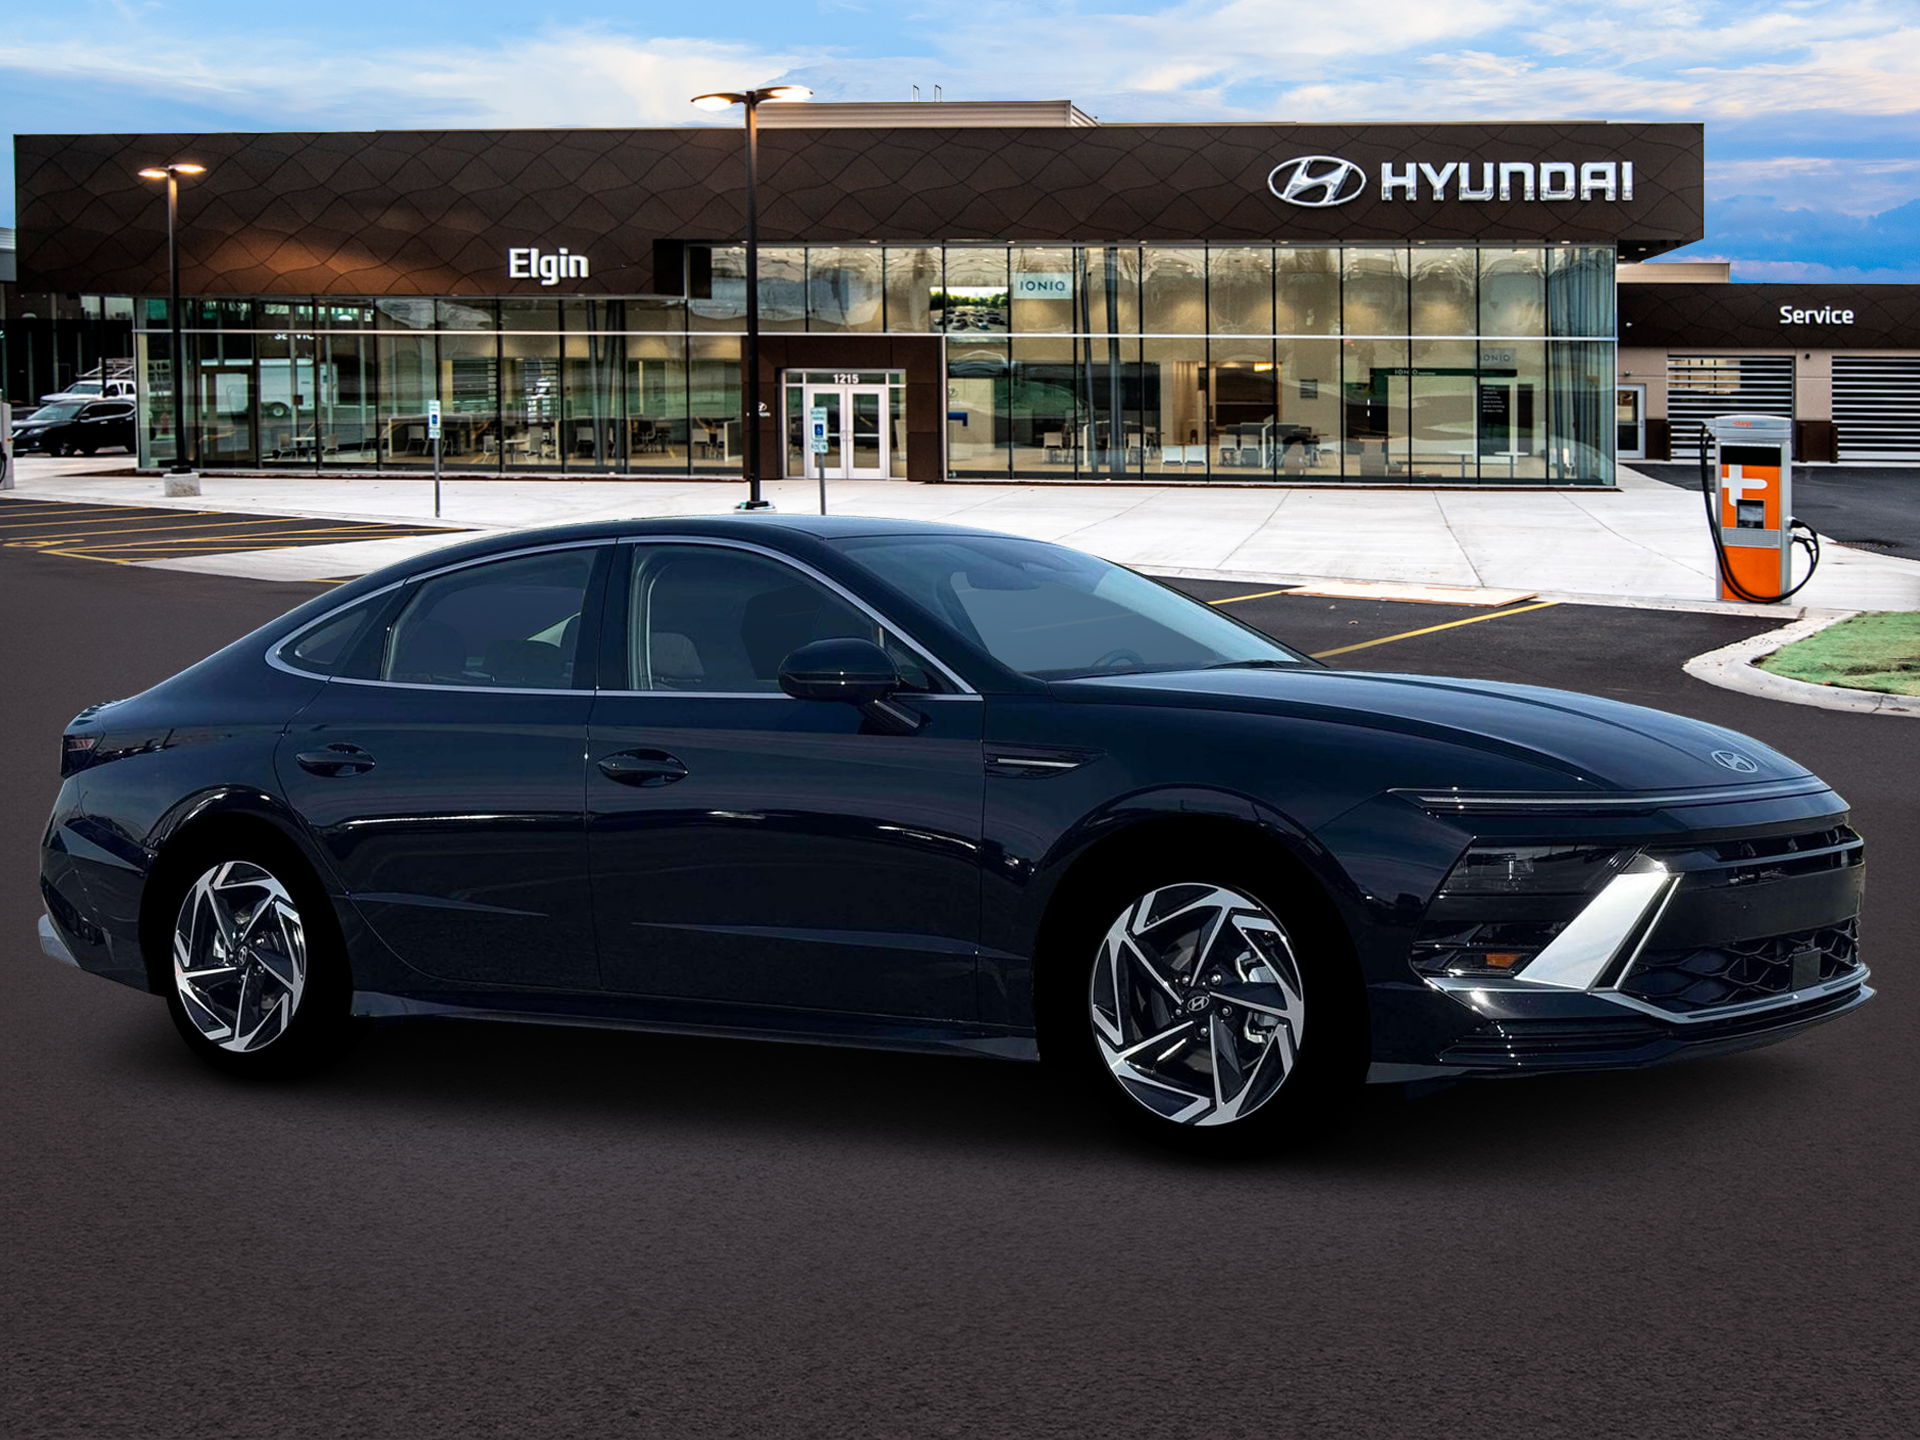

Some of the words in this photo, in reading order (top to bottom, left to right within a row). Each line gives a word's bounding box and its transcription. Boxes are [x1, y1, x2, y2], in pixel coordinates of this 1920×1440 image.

[1381, 161, 1633, 201] HYUNDAI
[509, 247, 590, 286] Elgin
[1020, 281, 1066, 291] IONIQ
[1779, 305, 1854, 324] Service
[833, 373, 860, 384] 1215
